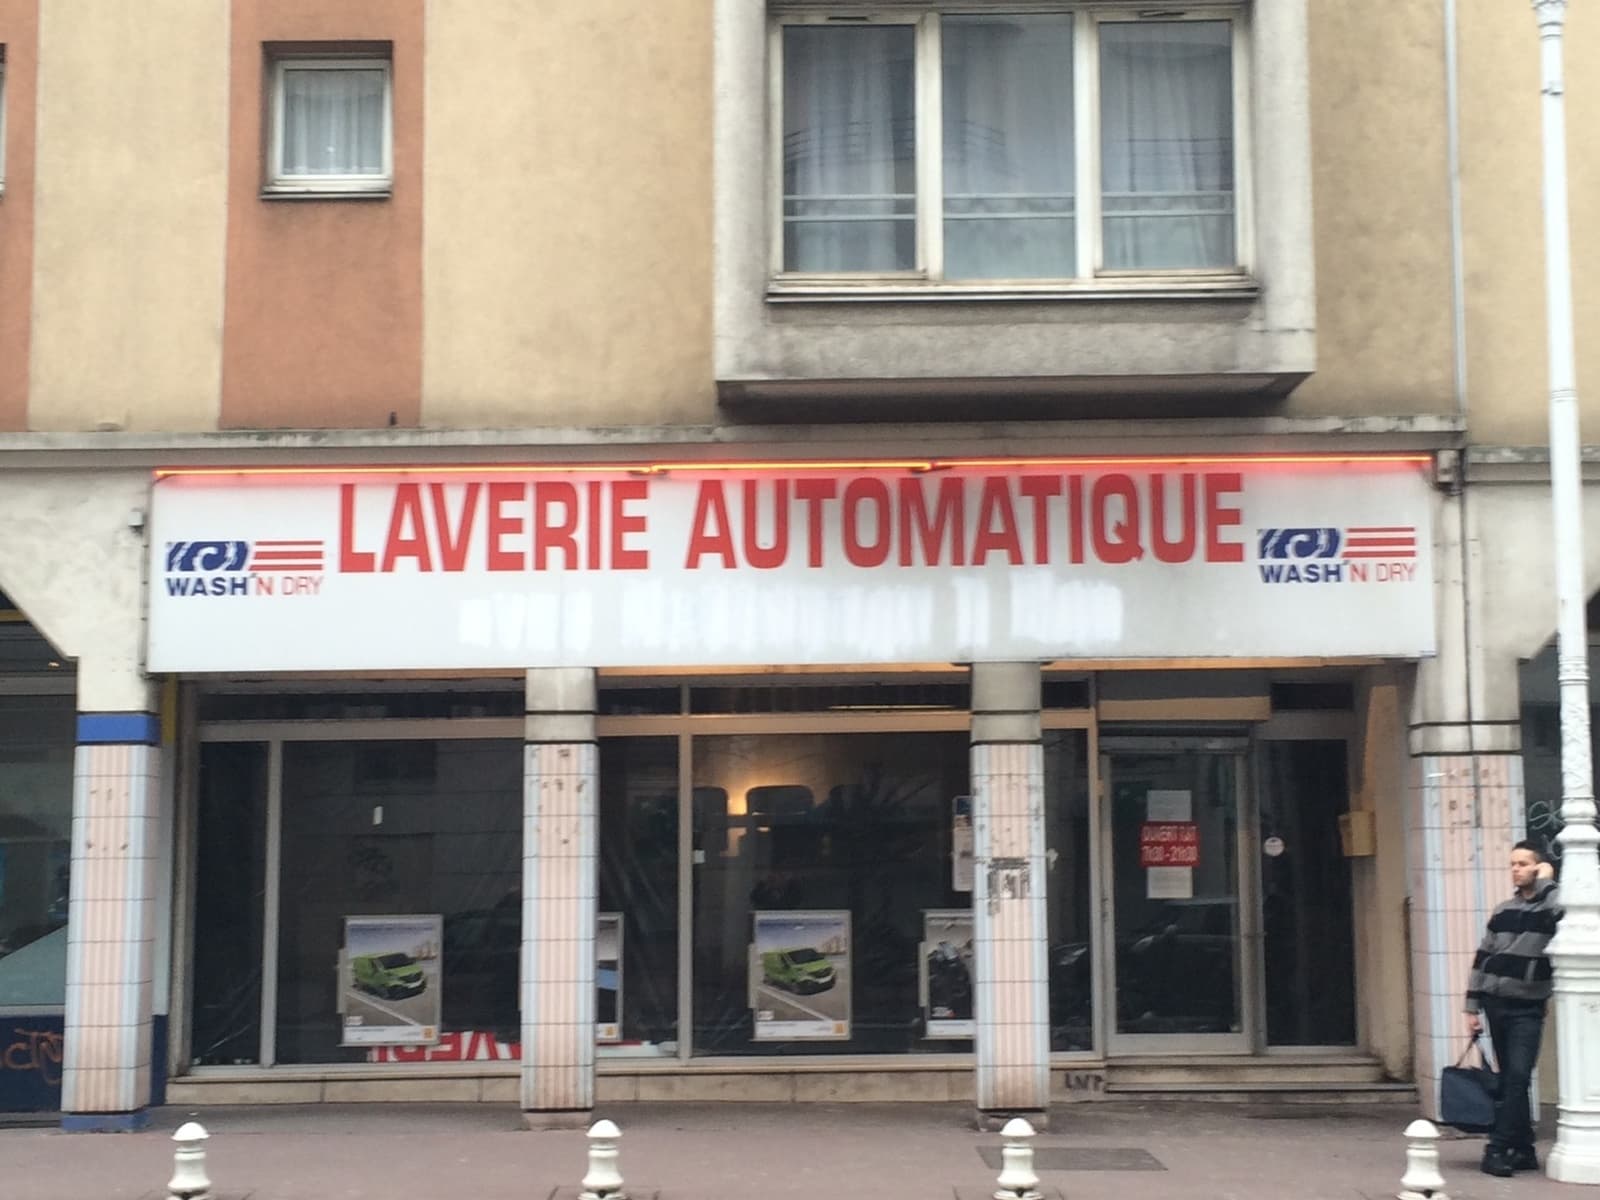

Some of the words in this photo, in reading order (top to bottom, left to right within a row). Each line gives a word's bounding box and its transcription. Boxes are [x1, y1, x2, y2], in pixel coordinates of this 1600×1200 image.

[338, 481, 648, 572] LAVERIE
[684, 473, 1244, 570] AUTOMATIQUE
[1376, 562, 1417, 583] DRY
[281, 576, 323, 596] DRY
